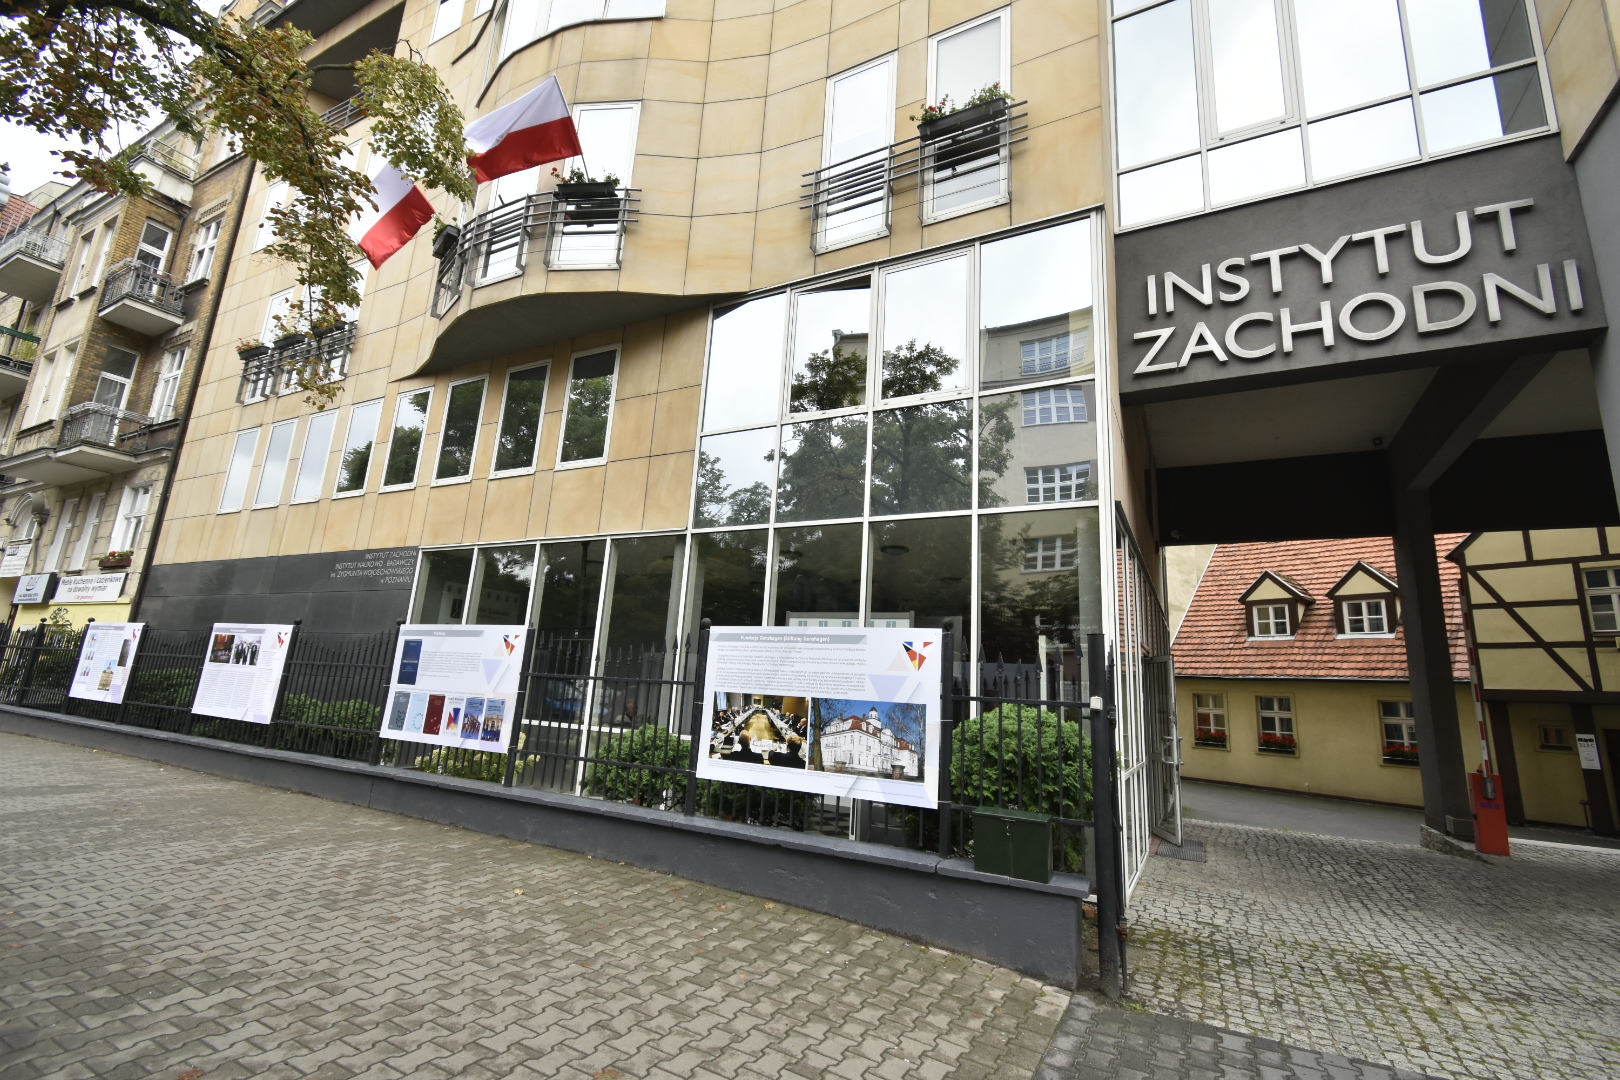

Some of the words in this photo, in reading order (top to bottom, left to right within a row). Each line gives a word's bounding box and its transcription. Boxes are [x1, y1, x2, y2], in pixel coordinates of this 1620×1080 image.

[1147, 198, 1534, 315] INSTYTUT
[1133, 259, 1584, 375] ZACHODNI
[365, 552, 389, 560] INSTYTUT
[335, 562, 358, 570] INSTYTUT
[358, 560, 382, 568] NAUKOWO
[386, 558, 416, 566] BADAWCZY
[363, 568, 413, 577] WOJCIECHOWSKIEGO
